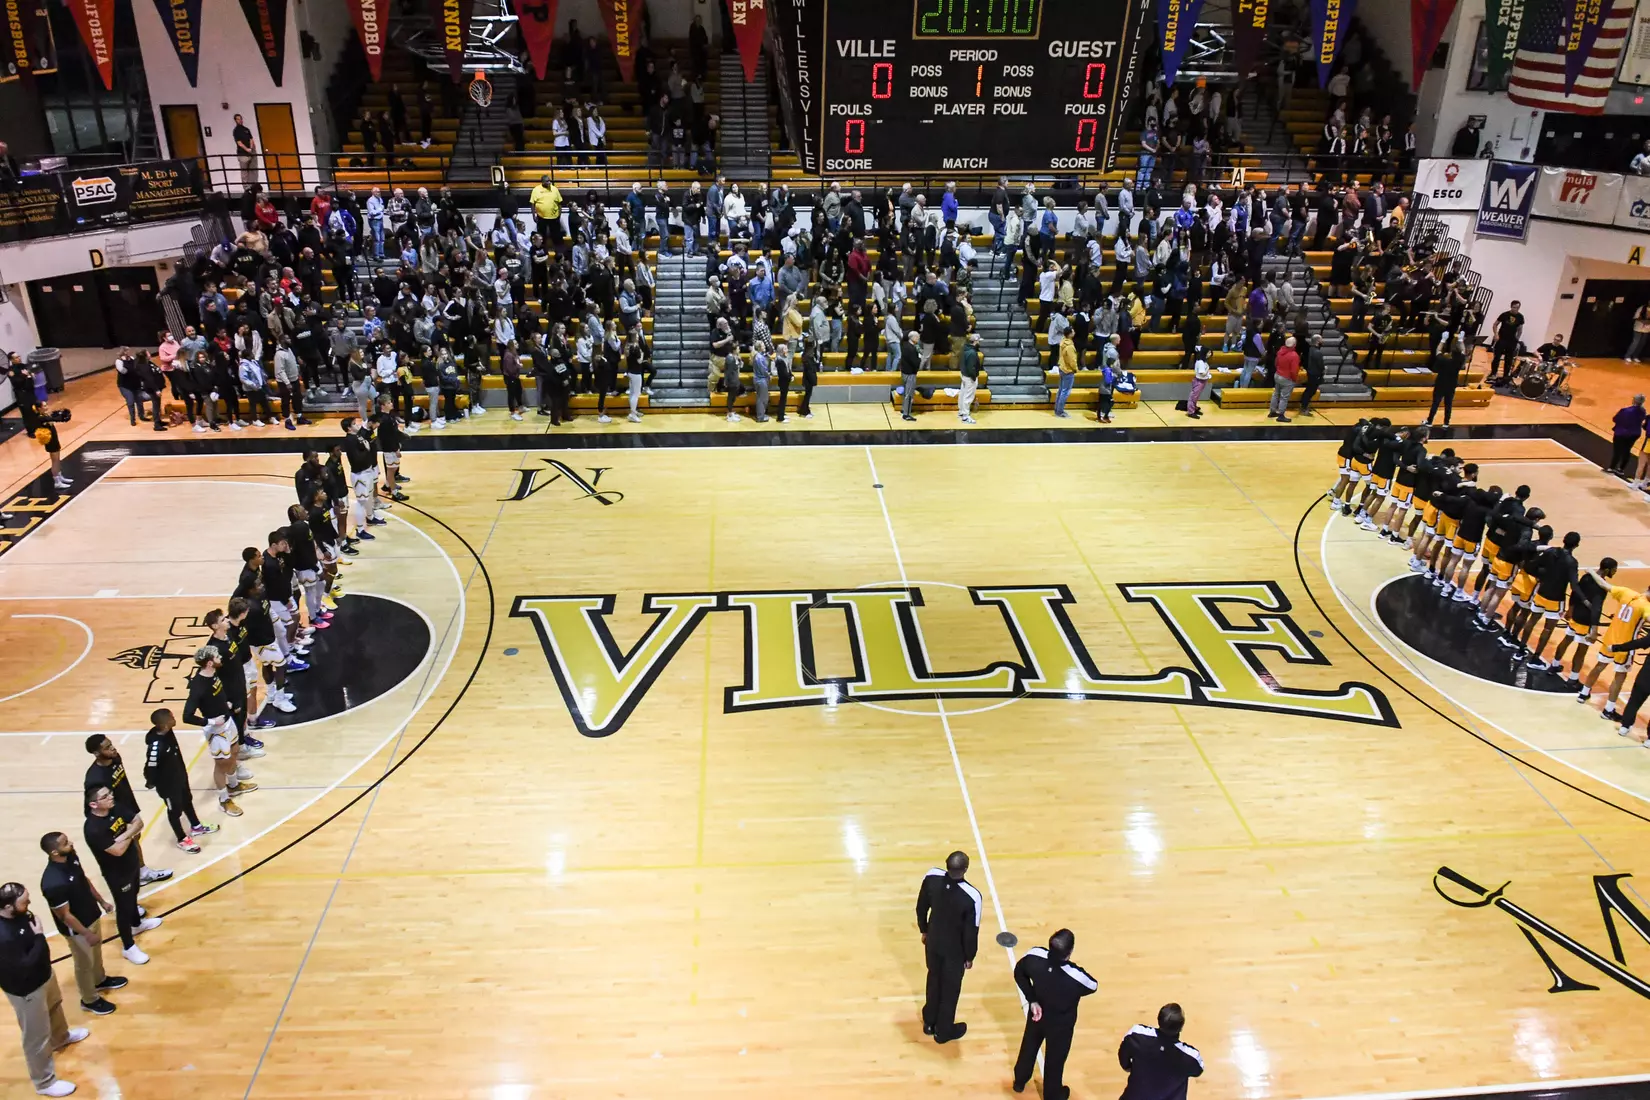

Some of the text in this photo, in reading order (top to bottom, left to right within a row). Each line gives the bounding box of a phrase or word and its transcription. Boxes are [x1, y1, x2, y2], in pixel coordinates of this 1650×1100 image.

[922, 0, 1034, 33] 20:00
[1567, 0, 1588, 51] ESTER
[85, 0, 110, 65] IFORNIA
[837, 39, 896, 58] VILLE
[949, 50, 998, 61] PERIOD
[1048, 40, 1116, 58] GUEST
[911, 65, 942, 77] POSS
[1003, 65, 1034, 77] POSS
[793, 0, 815, 170] MILLERSVILLE
[872, 63, 893, 99] 0
[976, 64, 983, 97] 1
[1083, 63, 1106, 99] 0
[1107, 0, 1149, 168] MILLERSVILLE
[909, 86, 948, 98] BONUS
[994, 86, 1032, 98] BONUS
[830, 104, 873, 115] FOULS
[934, 103, 1028, 115] PLAYER FOUL
[1064, 104, 1106, 115] FOULS
[845, 119, 865, 153] 0
[1075, 118, 1097, 152] 0
[826, 158, 872, 170] SCORE
[942, 157, 988, 169] MATCH
[1050, 157, 1095, 169] SCORE
[1233, 168, 1243, 186] A
[75, 182, 115, 199] PSAC
[135, 186, 193, 200] MANAGEMENT
[1433, 189, 1463, 199] ESCO
[1481, 210, 1525, 225] WEAVER
[88, 248, 104, 268] D
[1628, 246, 1641, 265] A
[1618, 603, 1634, 623] 10
[508, 580, 1401, 738] VILLE
